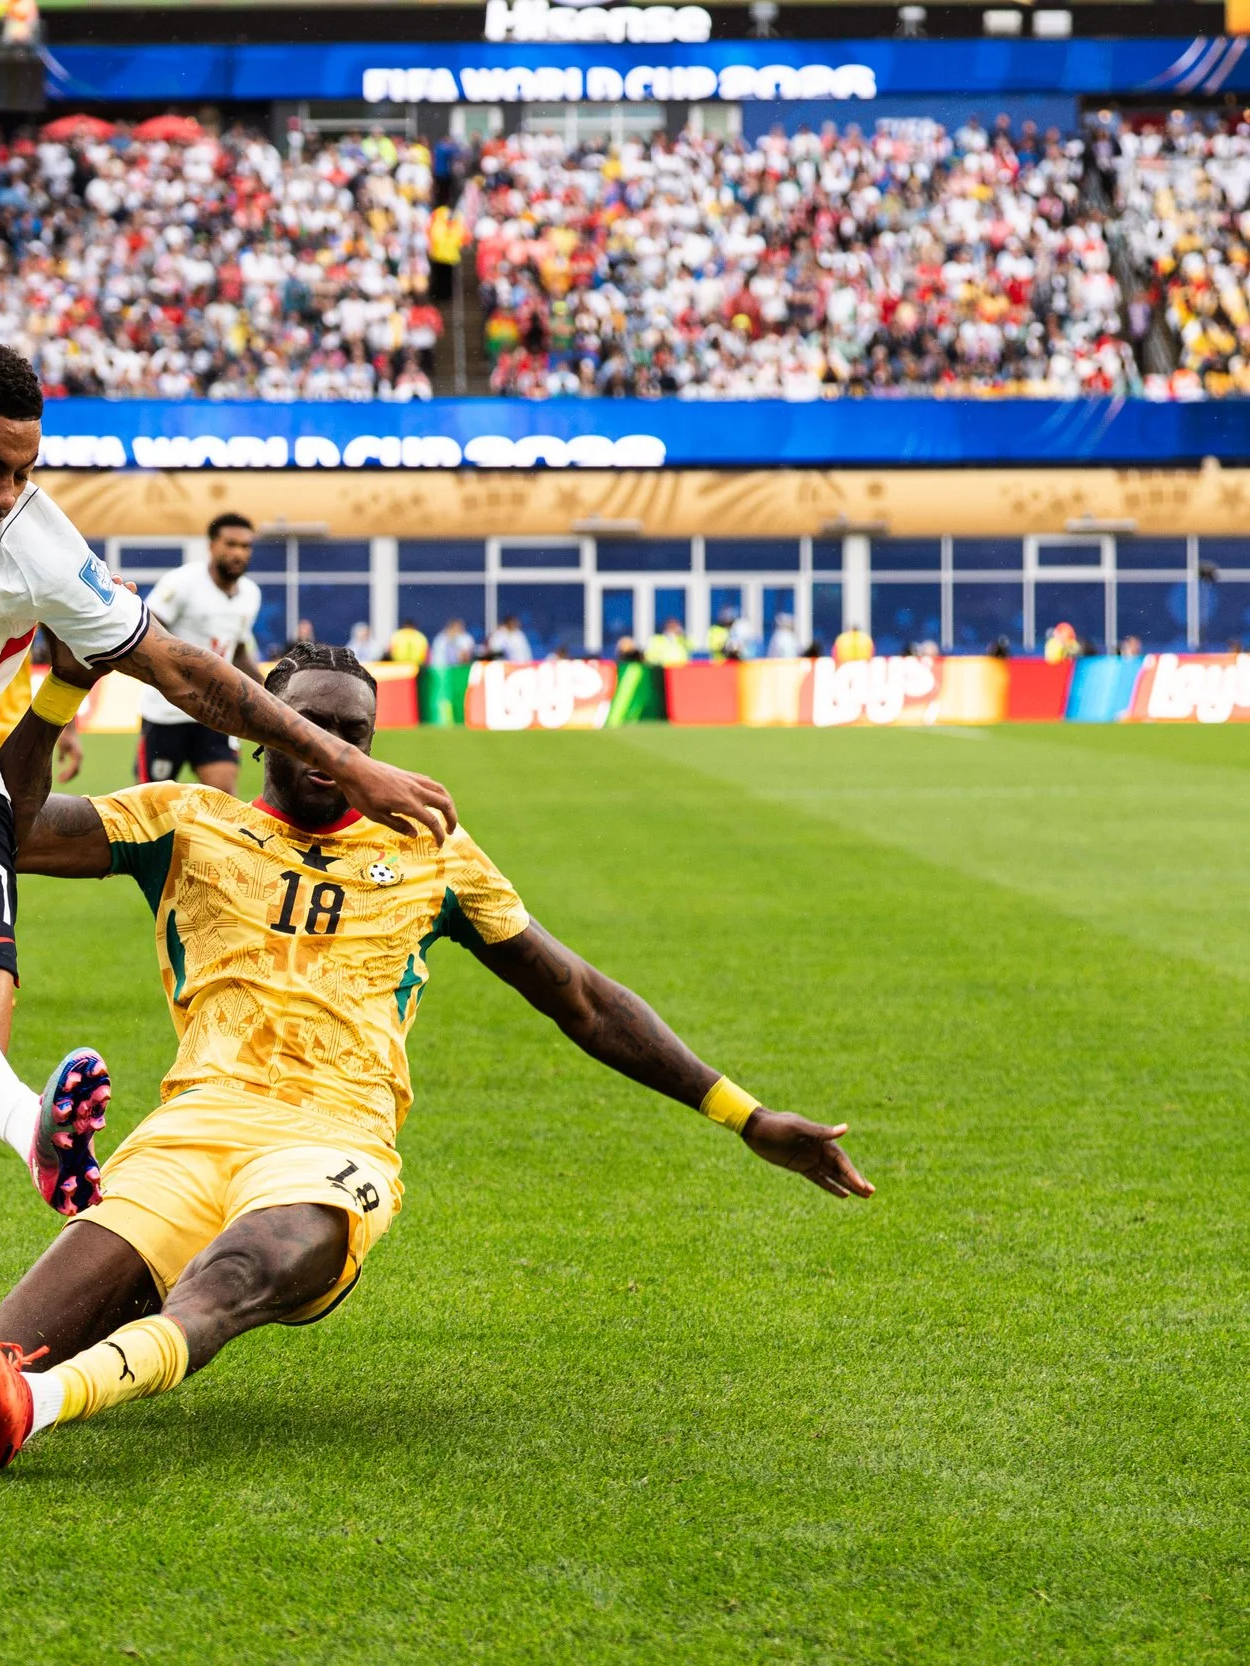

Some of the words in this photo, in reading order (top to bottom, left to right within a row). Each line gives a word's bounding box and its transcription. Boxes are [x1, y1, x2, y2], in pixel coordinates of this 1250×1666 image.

[485, 0, 711, 42] Hisense
[362, 67, 459, 102] FIFA
[460, 67, 623, 101] WORLD
[625, 66, 717, 100] CUP
[36, 435, 127, 467] IFA
[270, 870, 346, 935] 18
[325, 1158, 380, 1213] 18
